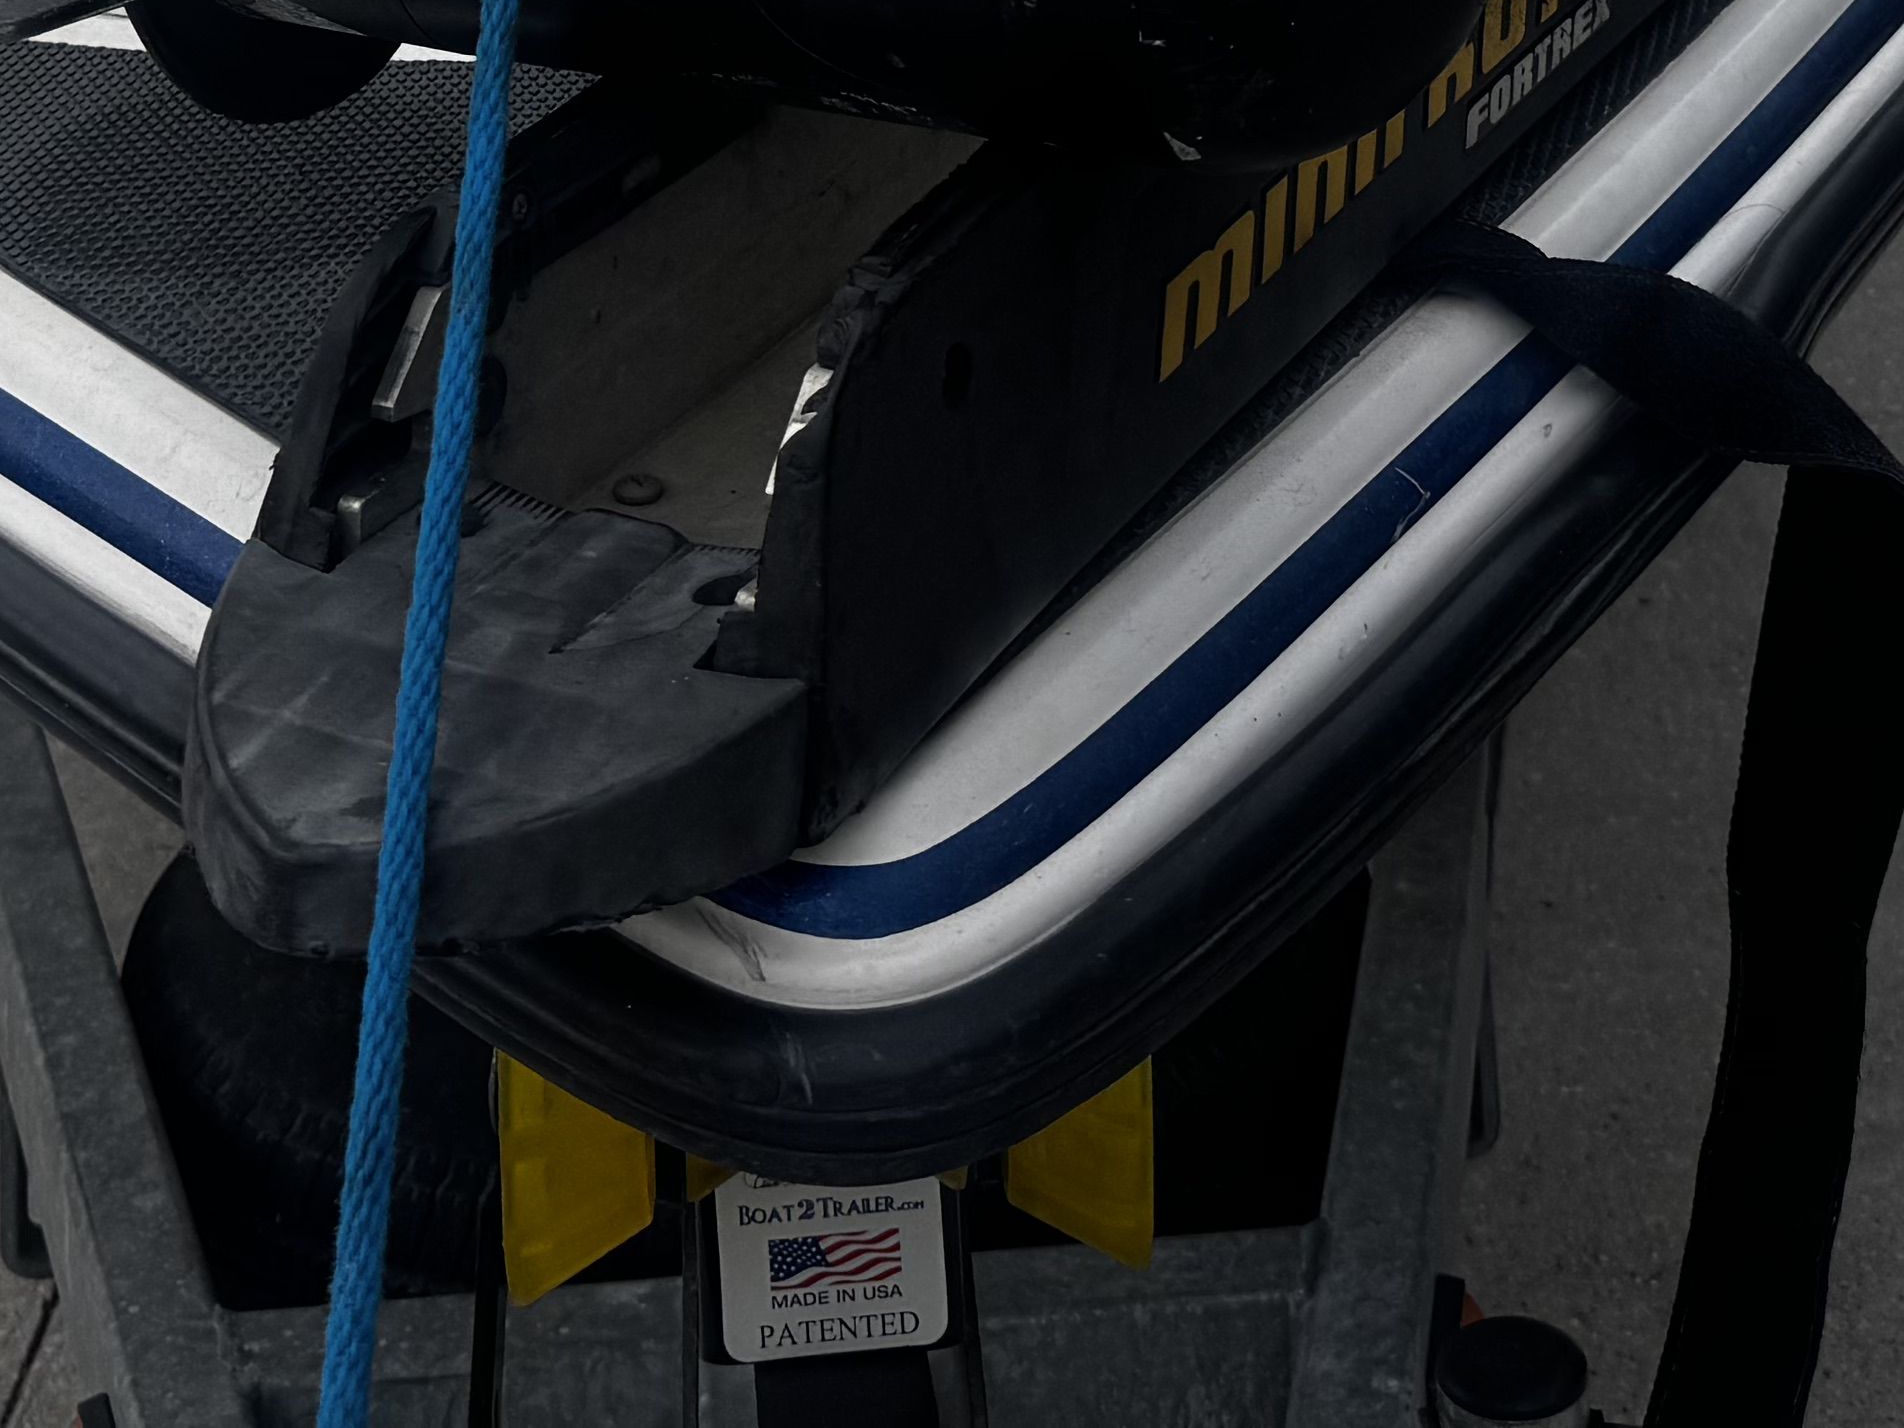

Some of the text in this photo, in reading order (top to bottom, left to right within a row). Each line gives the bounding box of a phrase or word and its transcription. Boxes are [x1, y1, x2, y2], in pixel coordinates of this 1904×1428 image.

[771, 1284, 903, 1310] MADE IN USA
[759, 1311, 921, 1349] PATENTED
